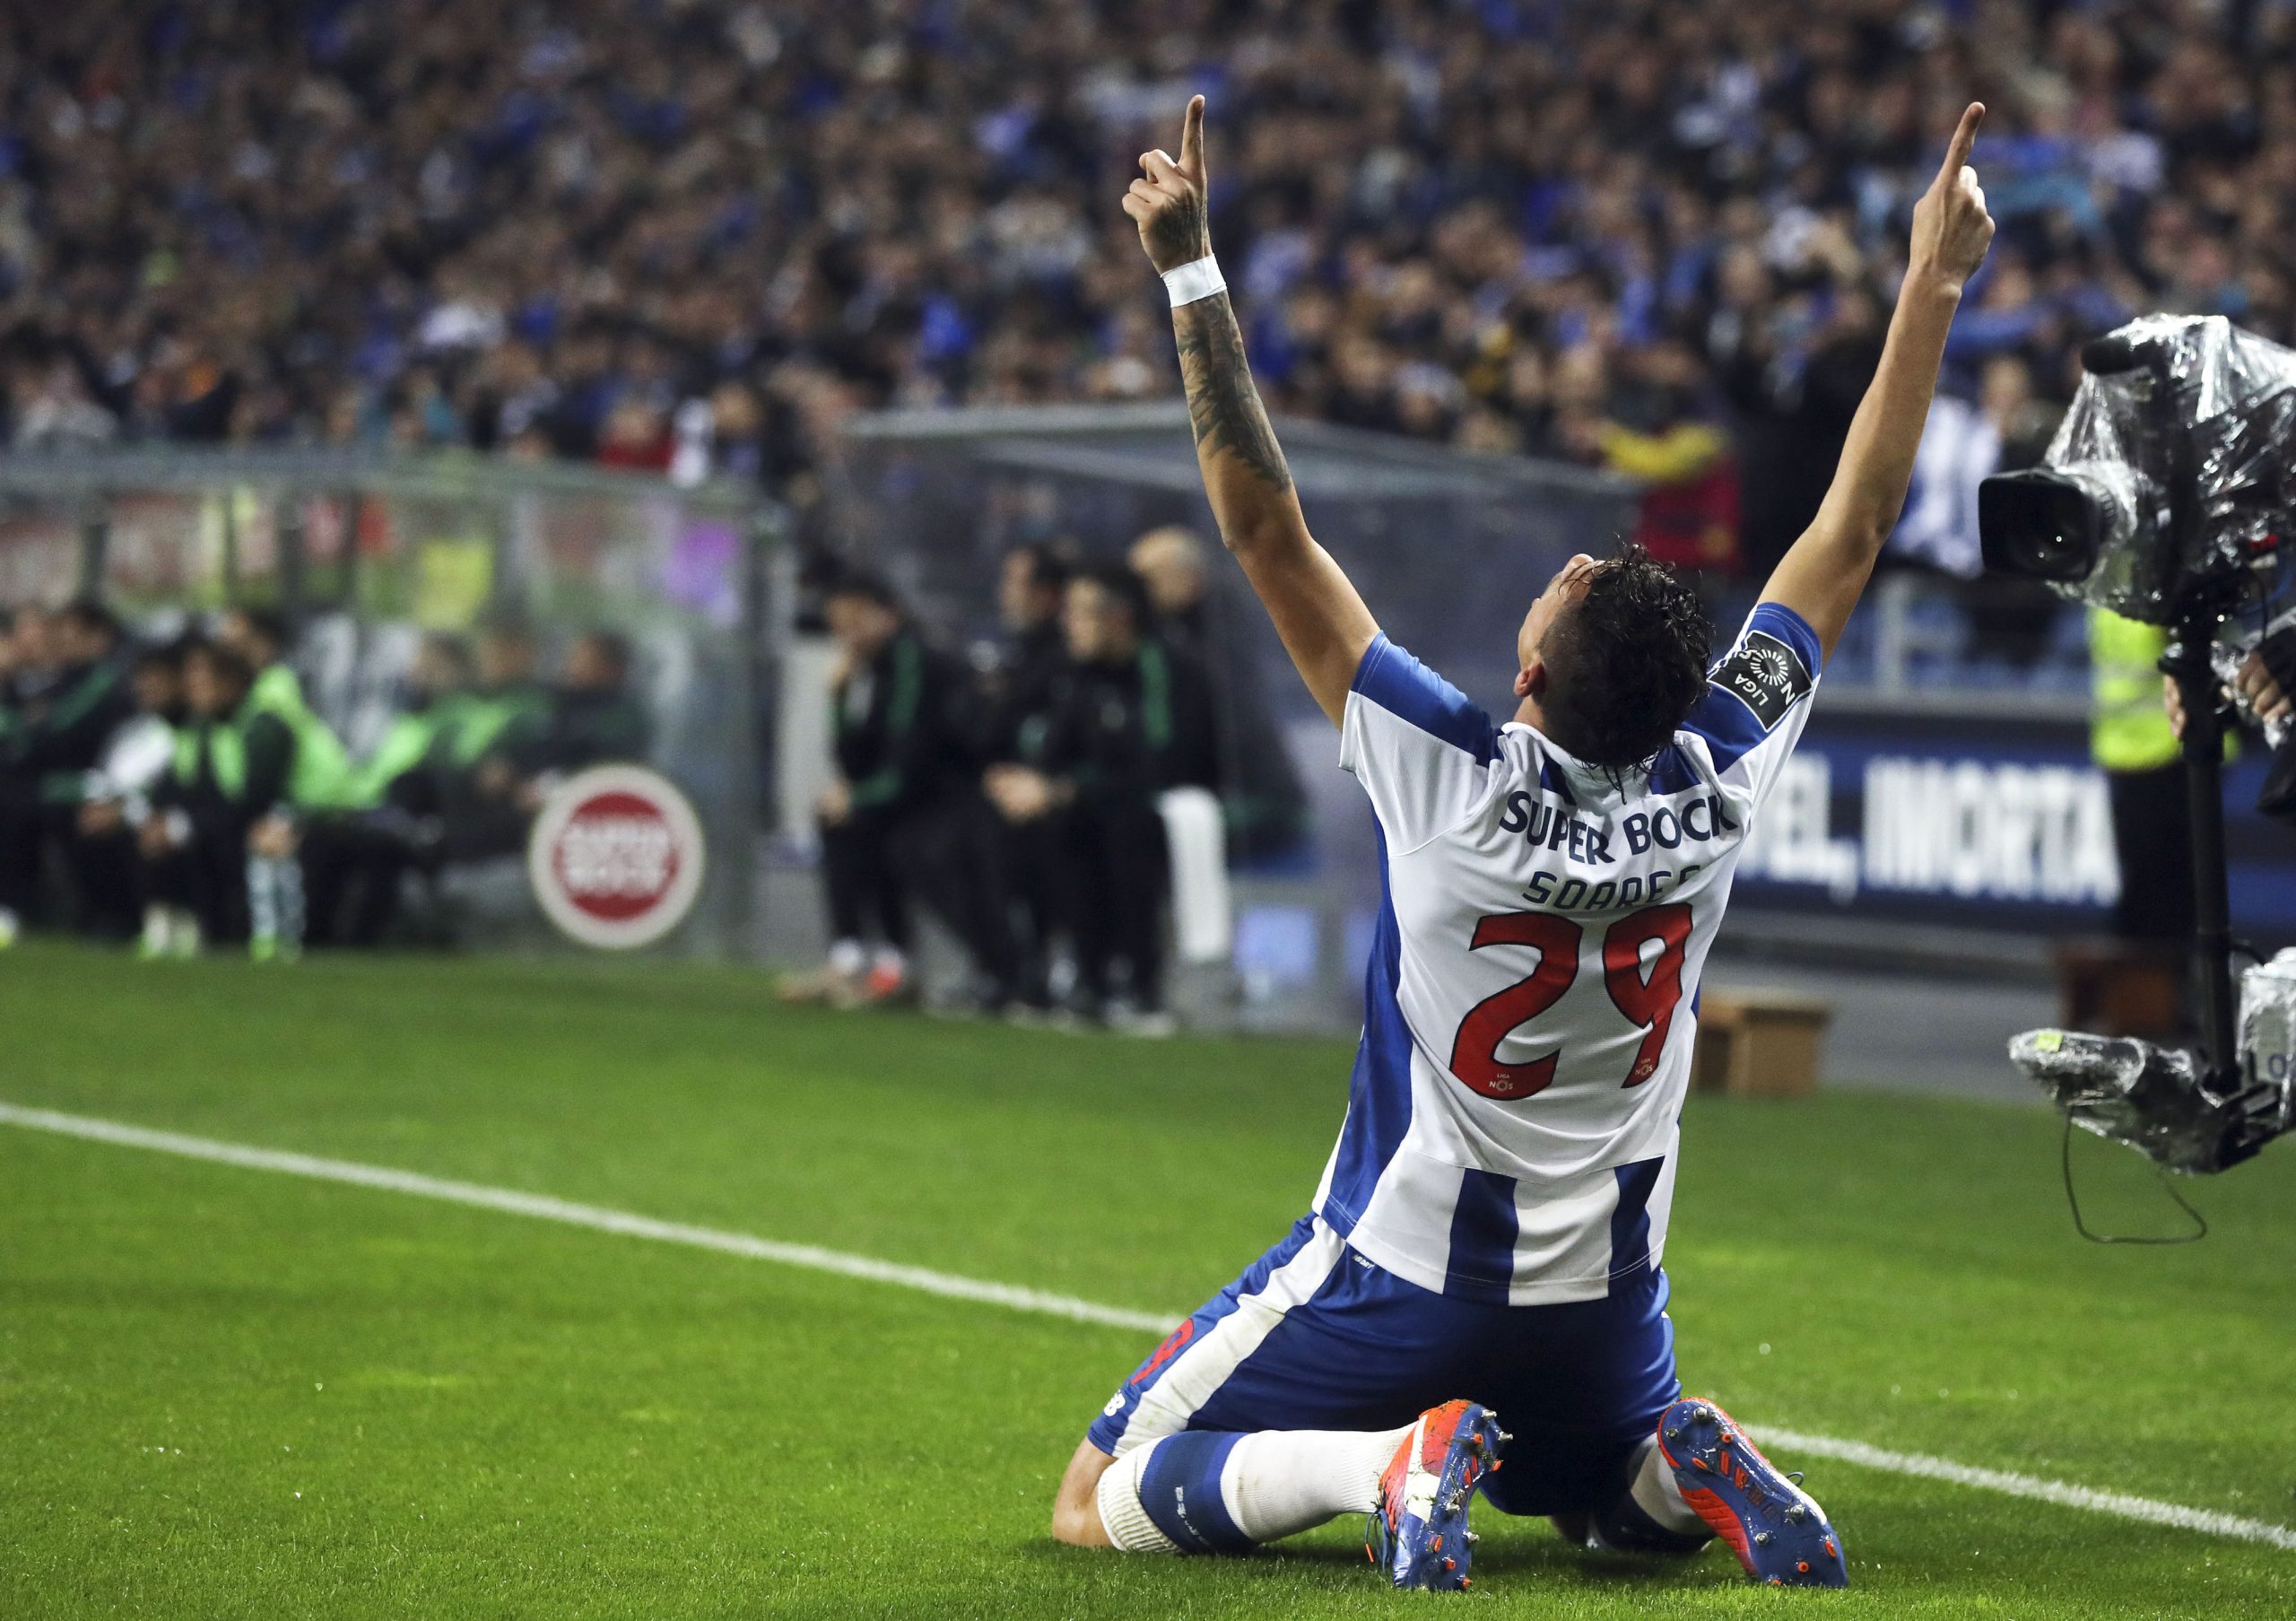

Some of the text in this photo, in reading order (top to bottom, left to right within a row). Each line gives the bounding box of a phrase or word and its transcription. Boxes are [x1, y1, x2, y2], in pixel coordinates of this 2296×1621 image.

[1735, 674, 1770, 706] LIGA
[1499, 790, 1738, 865] SUPER BOCK
[1449, 902, 1693, 1101] 29
[1489, 1079, 1514, 1092] NOS
